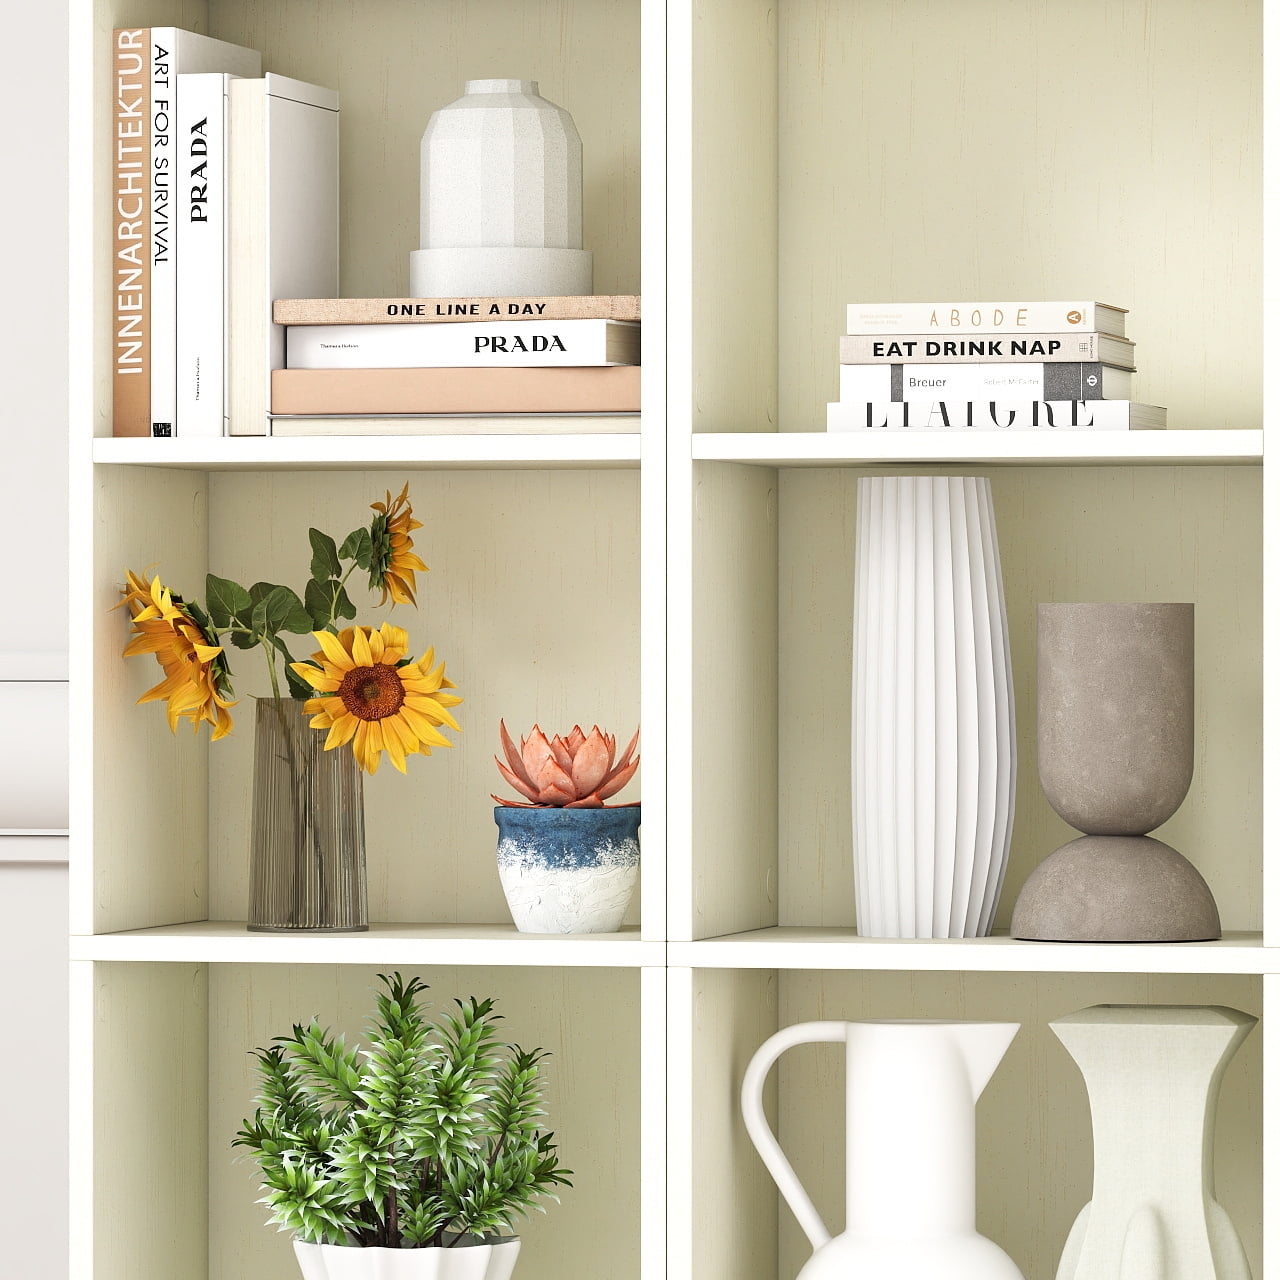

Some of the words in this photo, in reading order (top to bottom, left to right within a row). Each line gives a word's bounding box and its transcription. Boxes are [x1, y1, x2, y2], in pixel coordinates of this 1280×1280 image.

[154, 43, 170, 89] ART
[154, 99, 170, 148] FOR
[190, 116, 208, 224] PRADA
[118, 29, 143, 375] INNENARCHITEKTUR
[154, 156, 170, 267] SURVIVAL
[387, 304, 426, 316] ONE
[436, 303, 480, 316] LINE
[488, 303, 501, 315] A
[508, 302, 547, 315] DAY
[930, 308, 1028, 327] ABODE
[474, 334, 568, 354] PRADA
[873, 341, 918, 357] EAT
[925, 341, 1004, 357] DRINK
[1010, 340, 1062, 356] NAP
[909, 377, 947, 388] Breuer
